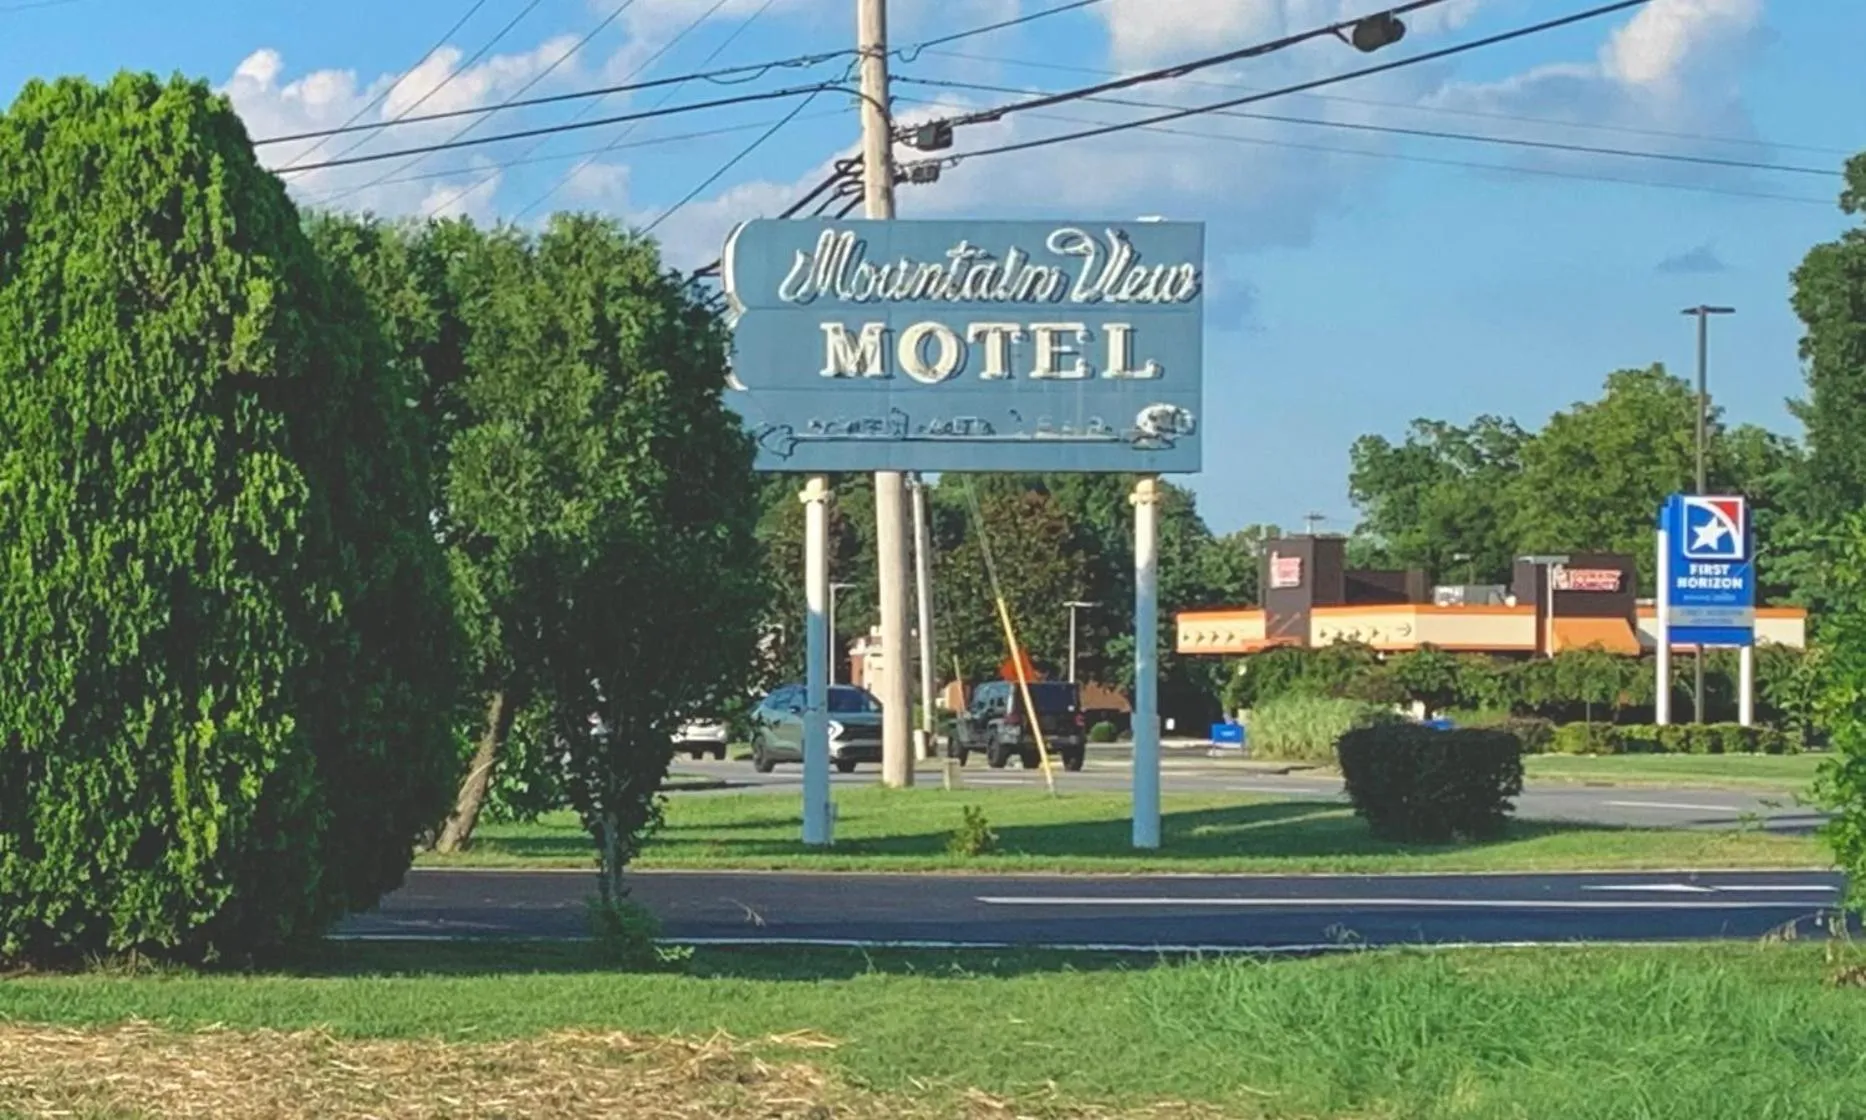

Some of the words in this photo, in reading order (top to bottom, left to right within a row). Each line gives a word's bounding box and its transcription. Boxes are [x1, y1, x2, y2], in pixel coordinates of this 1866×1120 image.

[778, 227, 1067, 304] Mountain
[1045, 227, 1202, 304] View
[818, 321, 1161, 384] MOTEL
[1676, 577, 1744, 590] HORIZON
[1689, 563, 1731, 576] FIRST
